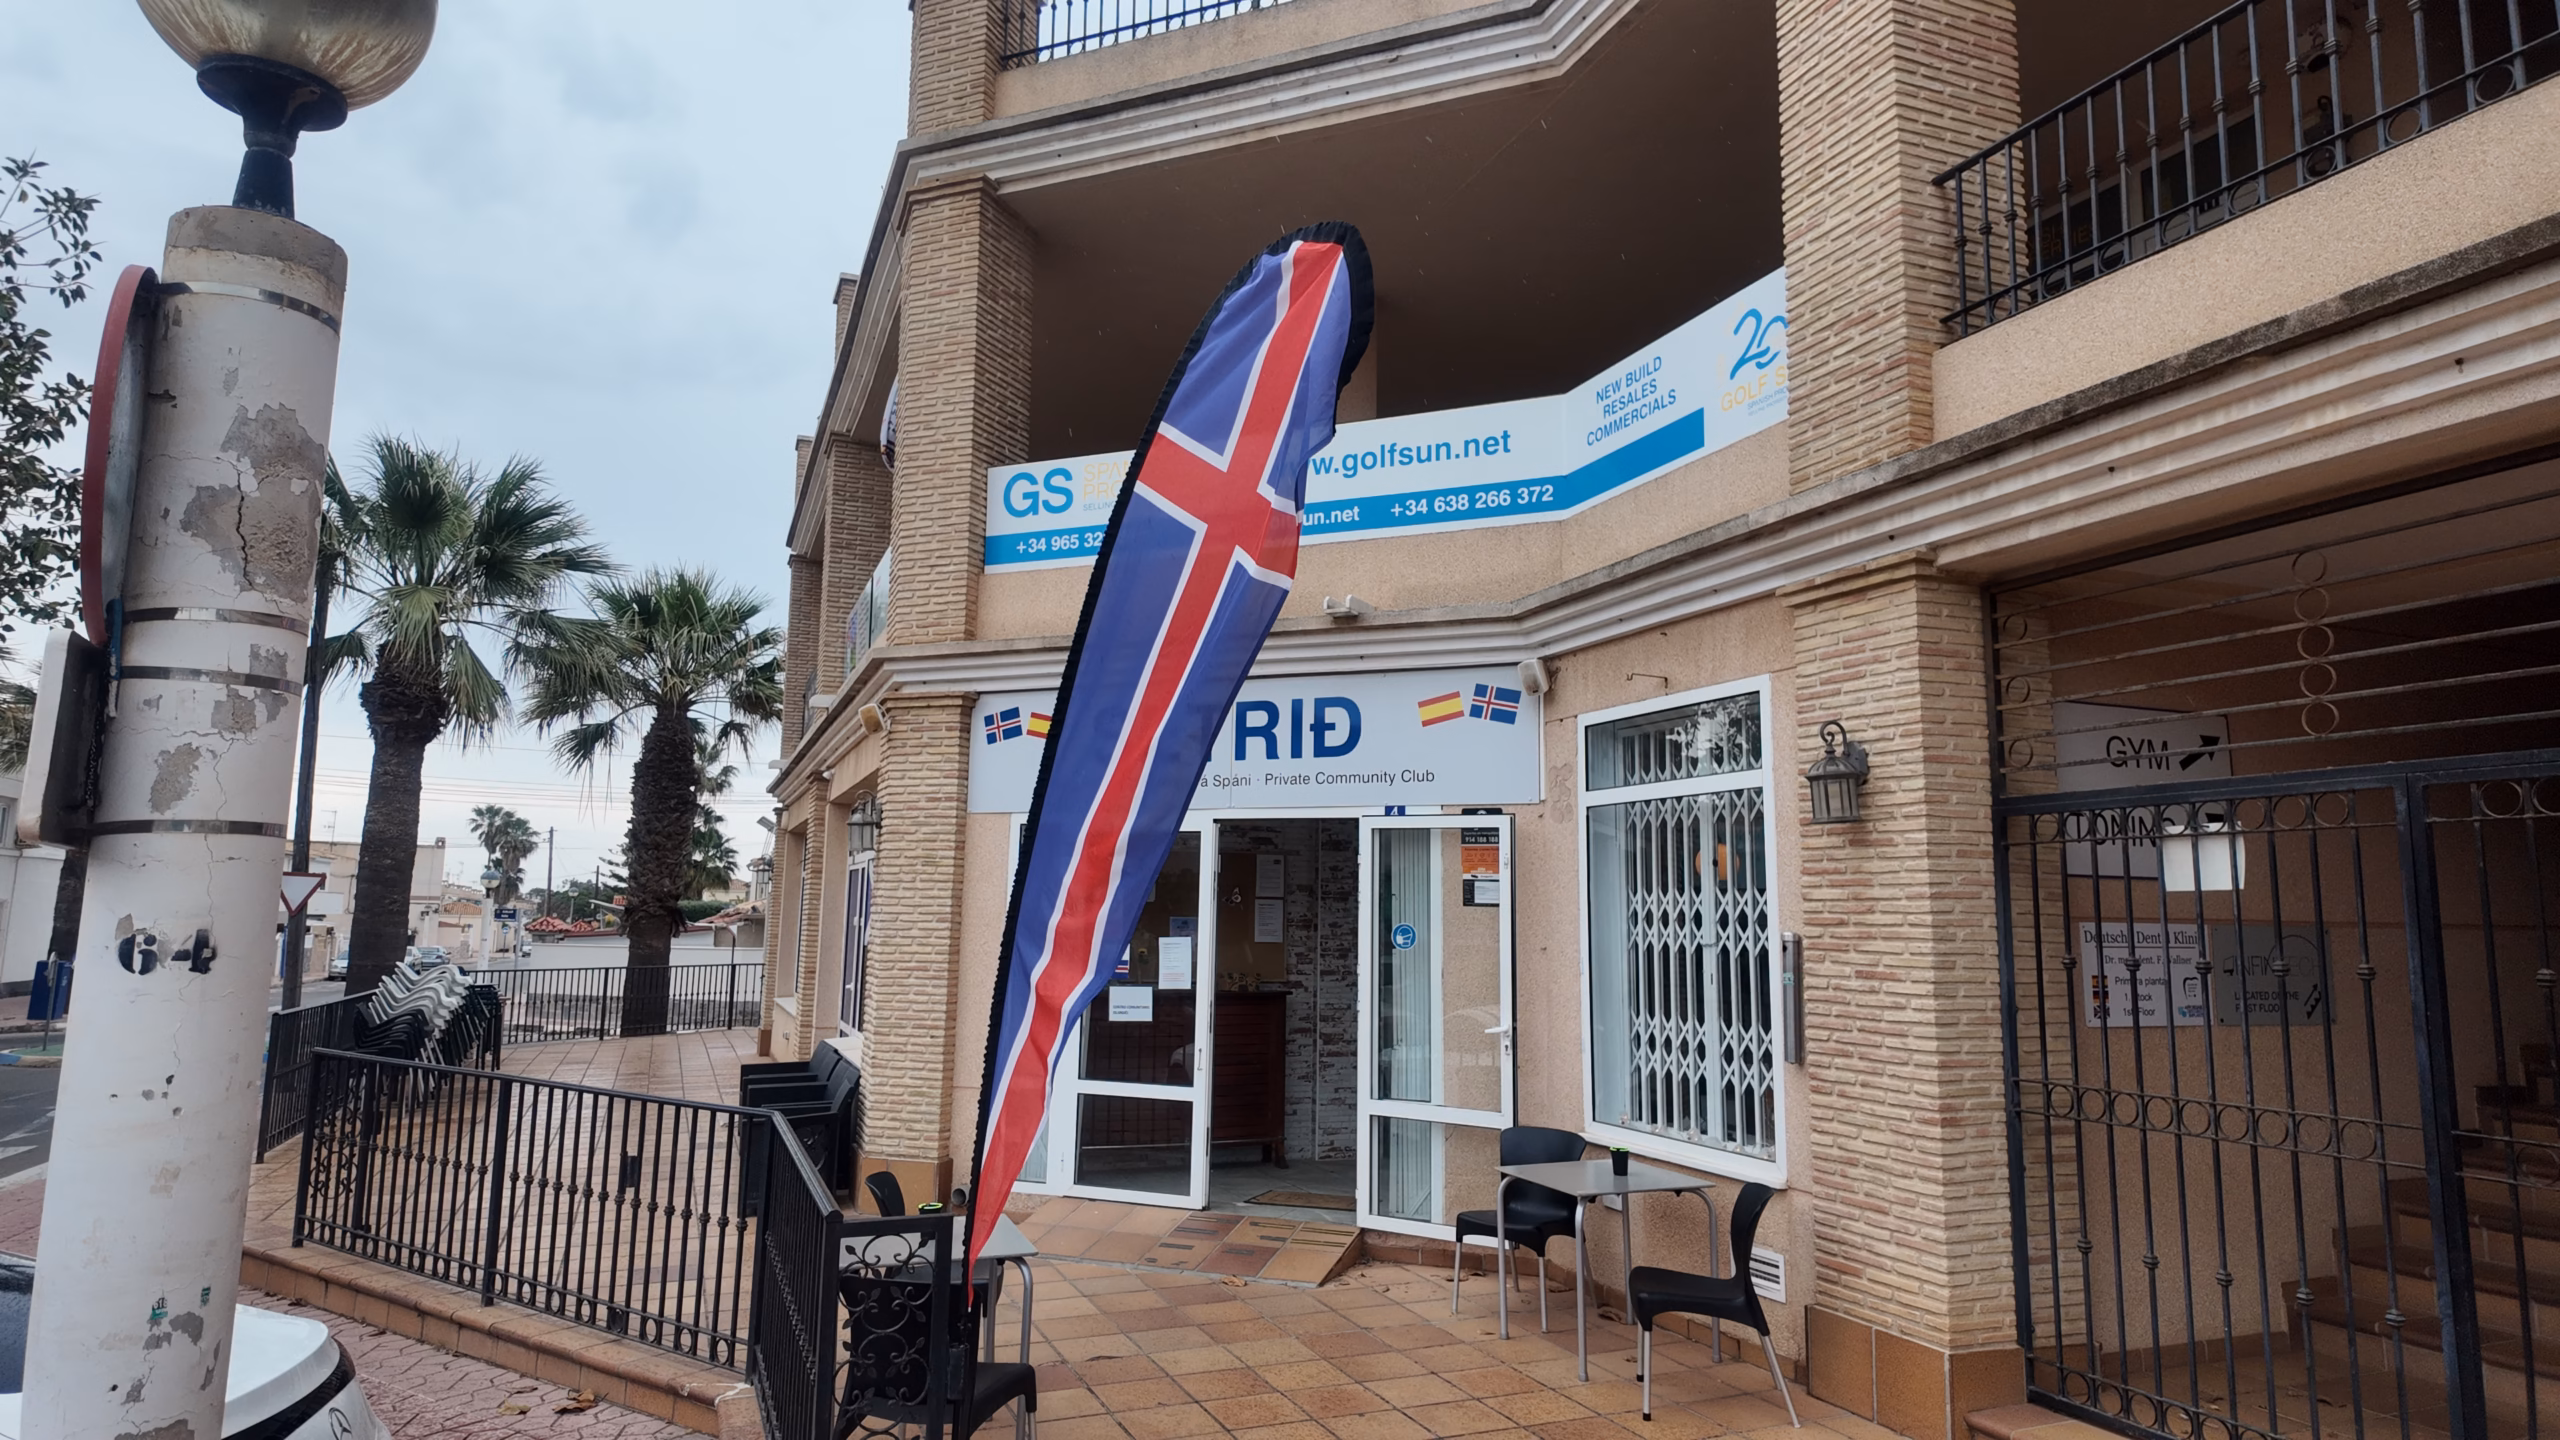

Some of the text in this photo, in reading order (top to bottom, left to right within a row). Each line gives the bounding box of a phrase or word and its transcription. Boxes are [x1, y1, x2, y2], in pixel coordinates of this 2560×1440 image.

[1595, 356, 1662, 405] NEW BUILD
[1721, 373, 1768, 412] GOLF
[1603, 378, 1658, 419] RESALES
[1587, 388, 1677, 446] COMMERCIALS
[1308, 430, 1511, 479] w.golfsun.net
[1003, 467, 1074, 518] GS
[1391, 484, 1553, 517] +34 638 266 372
[1016, 531, 1106, 554] +34 965 32
[1207, 696, 1362, 762] RIÐ
[2106, 735, 2170, 770] GYM
[1213, 773, 1251, 789] Spáni
[1265, 772, 1310, 786] Private
[1315, 770, 1396, 787] Community
[1401, 768, 1435, 783] Club
[2069, 812, 2176, 847] TONIN
[2136, 931, 2170, 944] Dent
[2173, 931, 2198, 944] Klini
[2169, 954, 2192, 964] allner
[2235, 992, 2269, 1000] LCATED
[2236, 1004, 2280, 1012] FST FLOO
